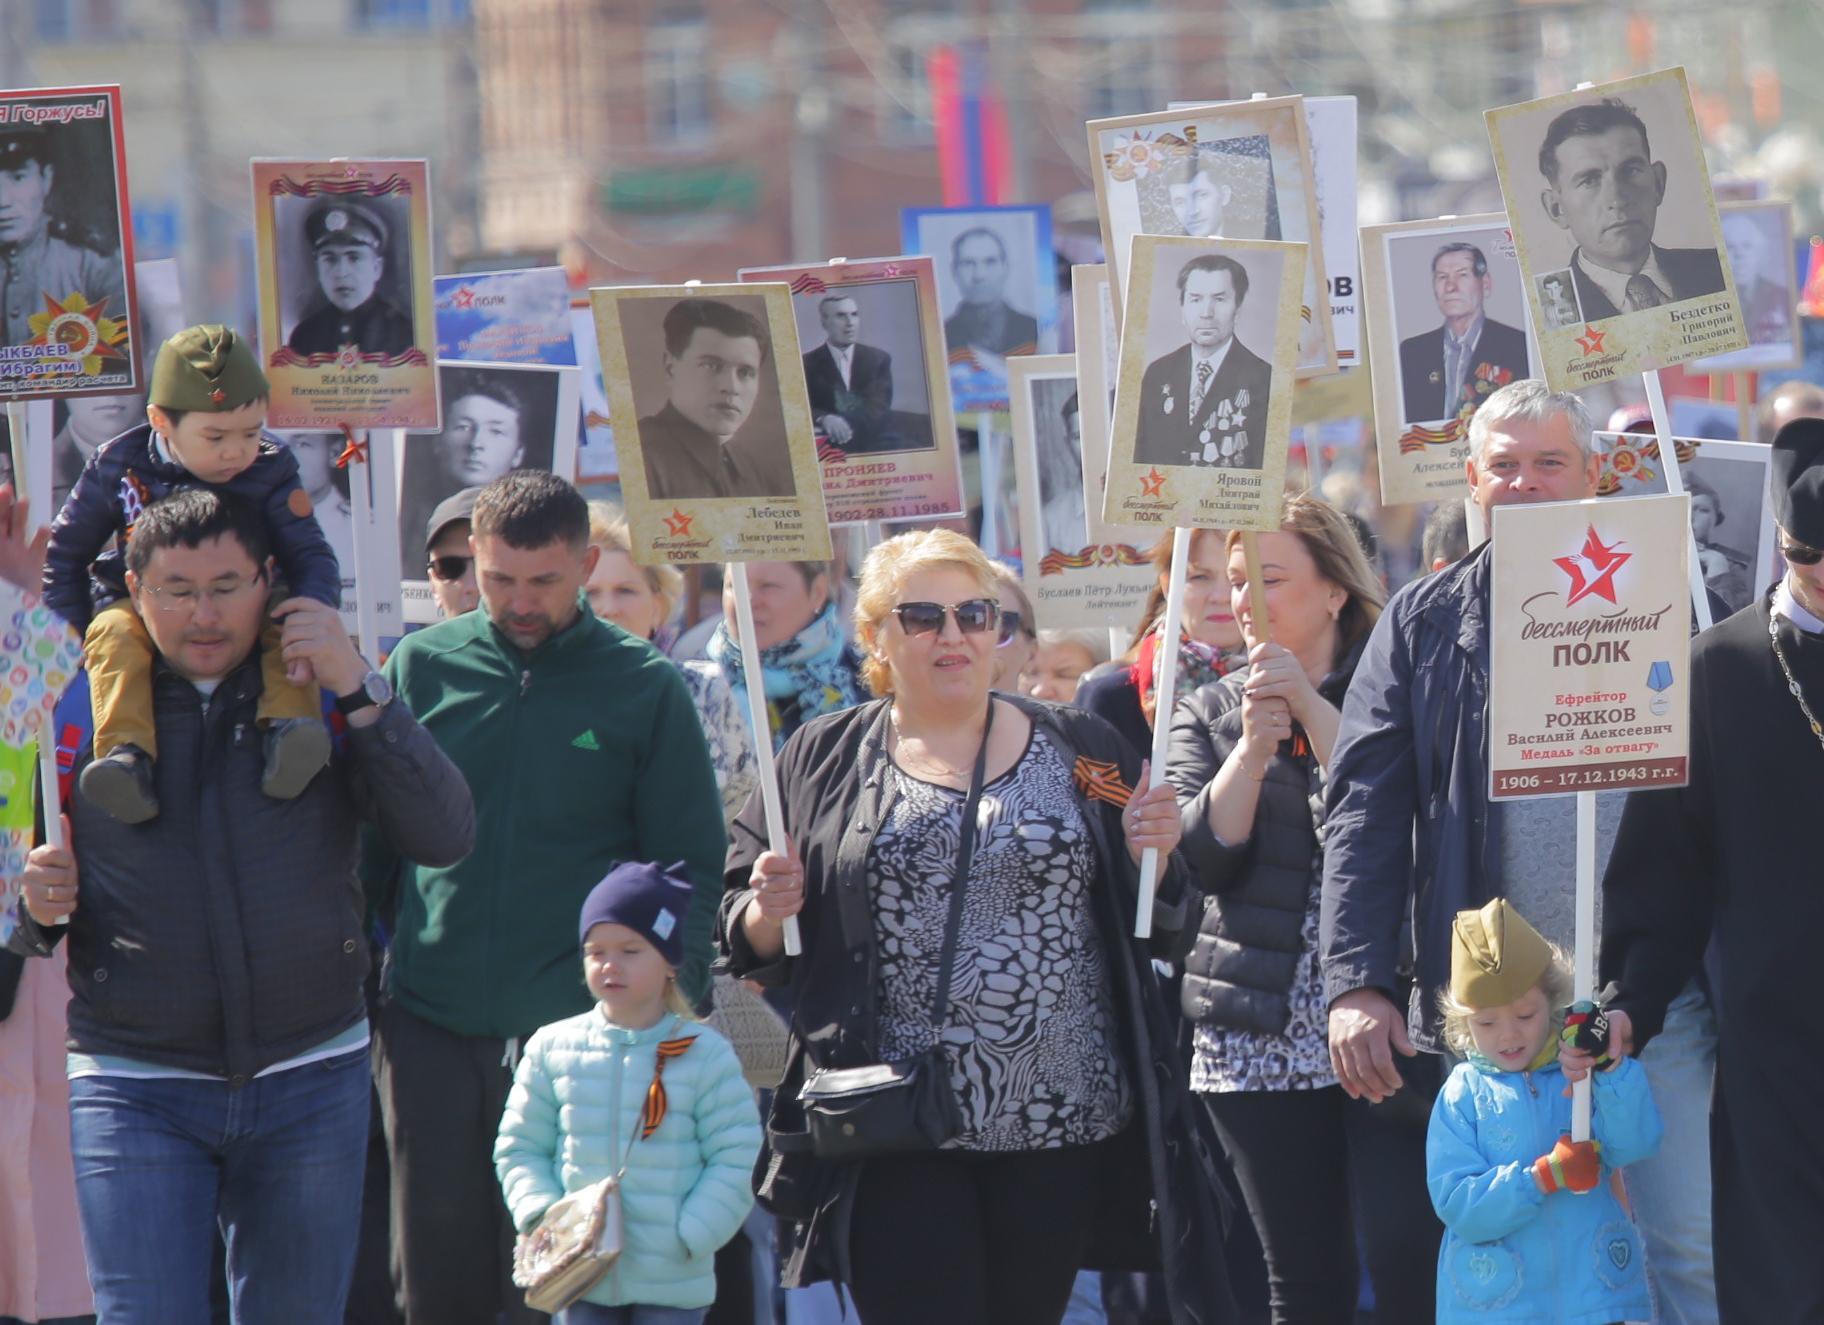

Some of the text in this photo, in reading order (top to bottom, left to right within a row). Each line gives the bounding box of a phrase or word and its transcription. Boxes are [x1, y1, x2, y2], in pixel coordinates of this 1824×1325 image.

[11, 99, 107, 125] Горжусь!
[1670, 302, 1731, 323] Бездетко
[1682, 314, 1734, 333] Григорий
[1681, 326, 1736, 345] Павлович
[1583, 366, 1614, 382] ПОЛК
[1217, 473, 1262, 487] Яровой
[1216, 488, 1261, 500] Дмитрий
[746, 507, 801, 519] Лебедев
[1199, 499, 1260, 511] Михайлович
[1134, 511, 1162, 522] ПОЛК
[775, 521, 803, 530] Иван
[737, 533, 805, 544] Дмитриевич
[667, 550, 699, 560] ПОЛК
[1038, 586, 1081, 600] Буслаев
[1084, 584, 1112, 598] Пётр
[1521, 591, 1672, 642] бессмертный
[1553, 640, 1631, 667] ПОЛК
[1555, 691, 1627, 707] Ефрейтор
[1545, 707, 1637, 728] РОЖКОВ
[1507, 724, 1673, 746] Василий Алексеевич
[1521, 741, 1659, 760] Медаль «За отвагу»
[1500, 775, 1540, 790] 1906
[1558, 767, 1647, 787] 17.12.1943
[1651, 767, 1679, 779] г.г.
